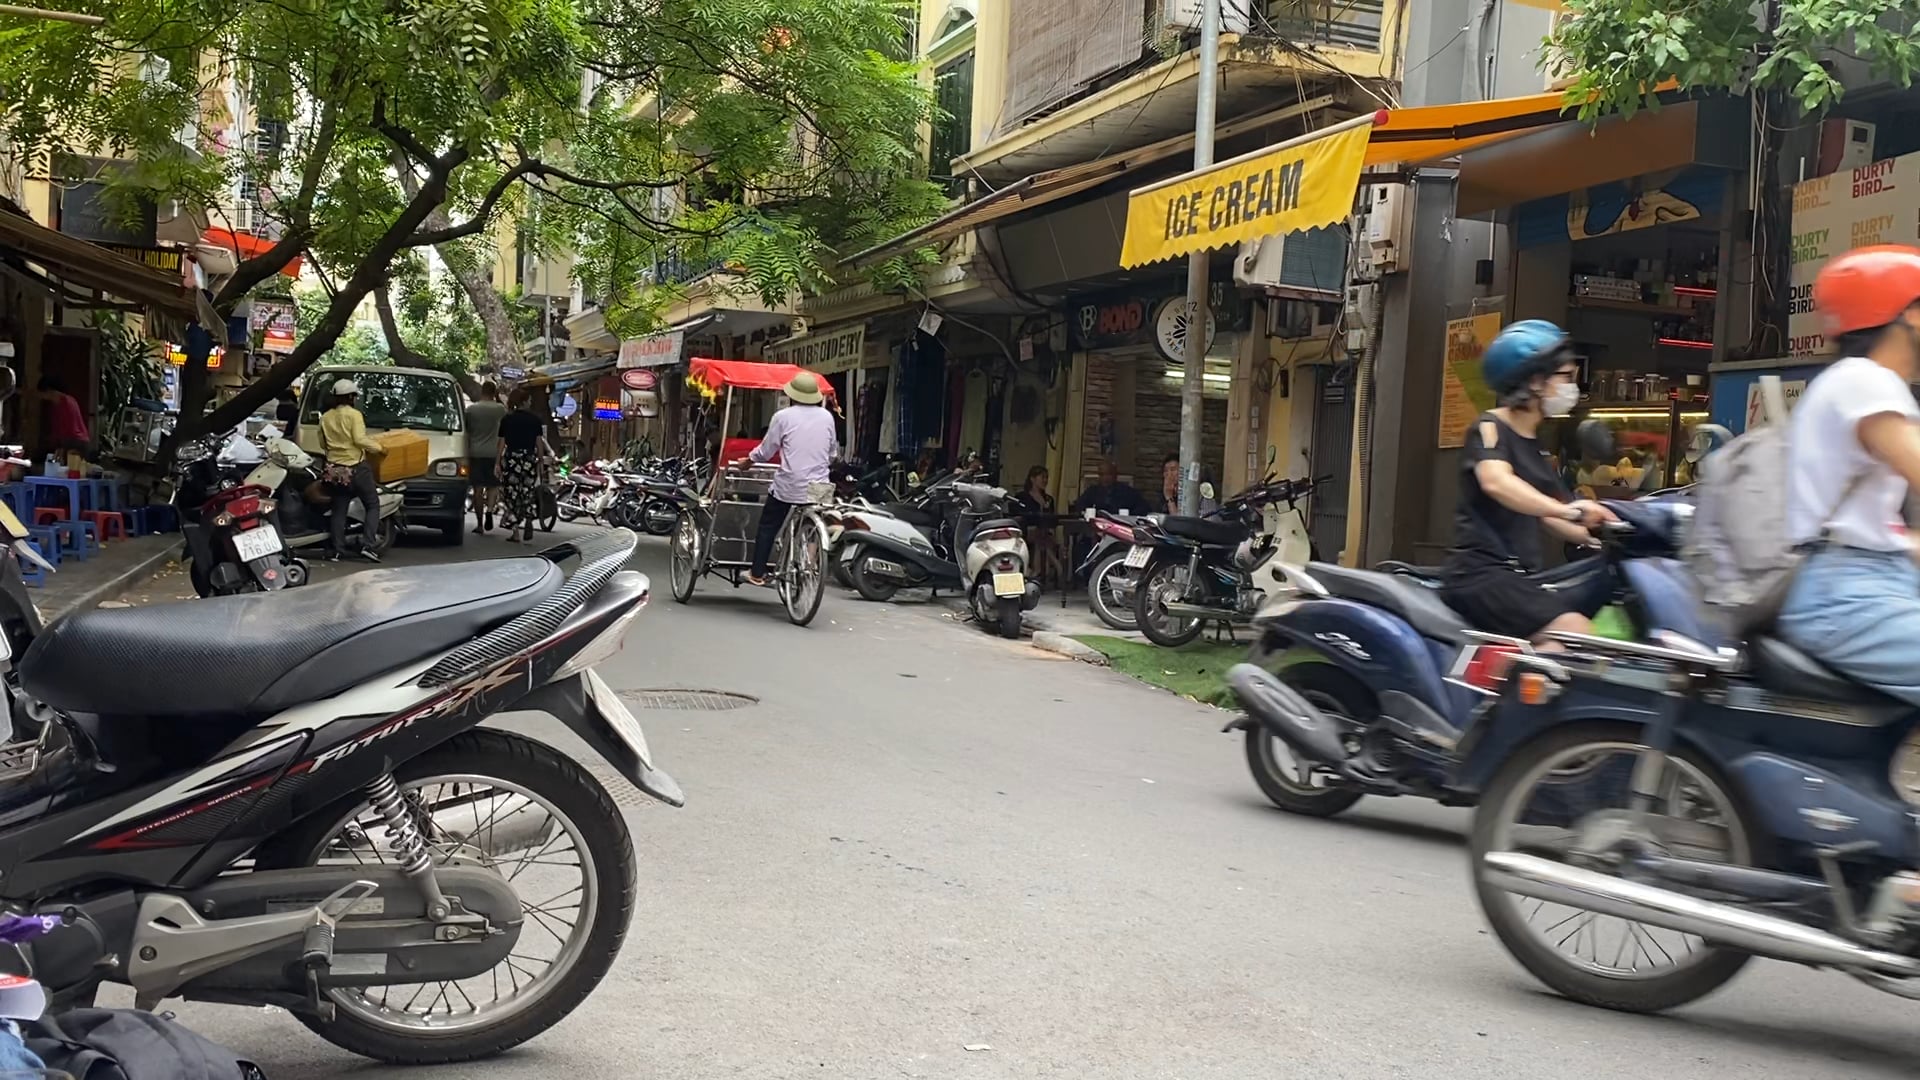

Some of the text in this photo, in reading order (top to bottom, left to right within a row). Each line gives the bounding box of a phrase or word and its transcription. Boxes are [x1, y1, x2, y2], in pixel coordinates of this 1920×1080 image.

[1852, 159, 1896, 184] DURTY
[1793, 176, 1831, 199] DURTY
[1165, 159, 1304, 241] ICE CREAM
[1851, 214, 1895, 237] DURTY
[1791, 228, 1830, 250] DURTY
[144, 249, 179, 271] HOLIDAY
[1100, 303, 1142, 334] BOND
[791, 329, 862, 367] EMBROIDERY
